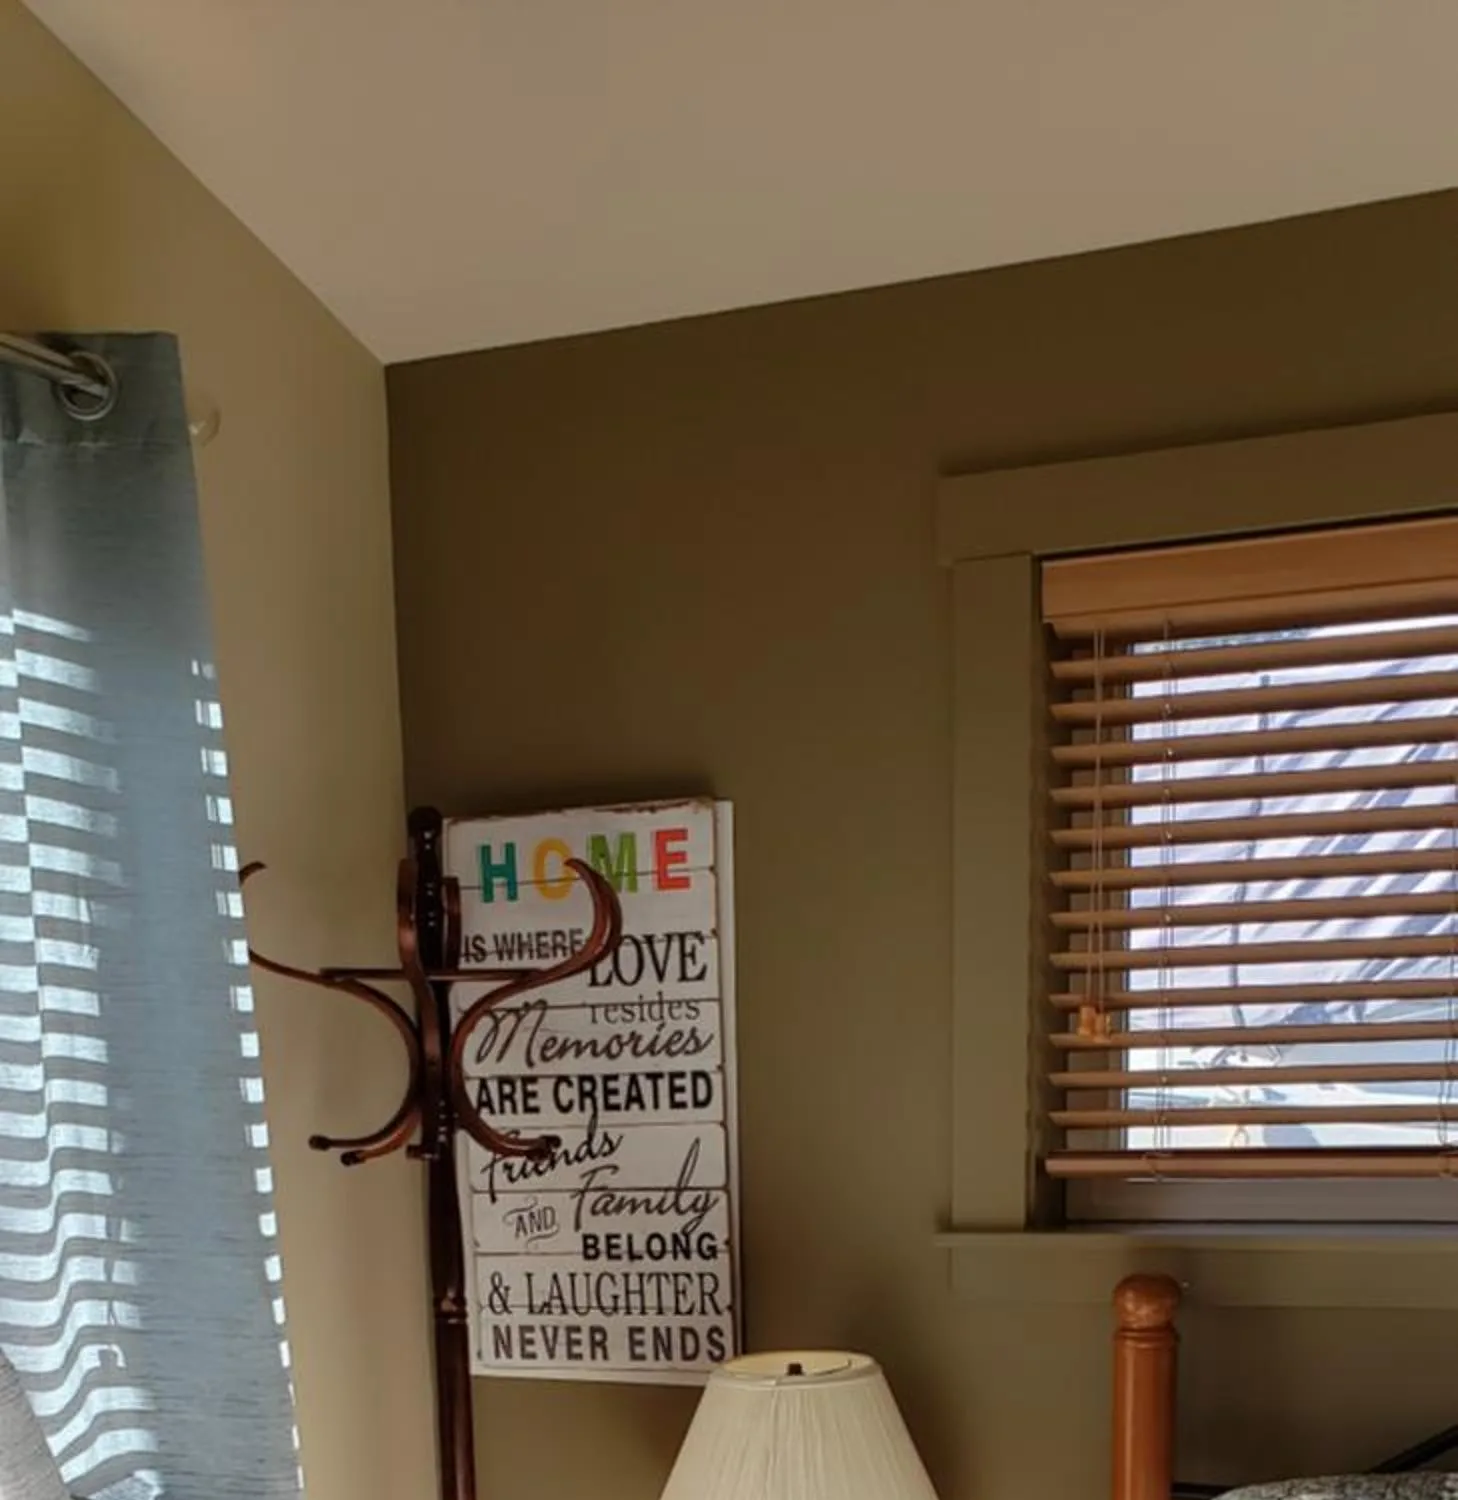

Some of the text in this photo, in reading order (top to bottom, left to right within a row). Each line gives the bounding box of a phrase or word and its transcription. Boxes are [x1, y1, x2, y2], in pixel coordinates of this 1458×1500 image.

[477, 828, 691, 903] HOME
[463, 928, 584, 963] IS WHERE
[590, 991, 701, 1025] resides
[474, 998, 714, 1068] Memories
[476, 1070, 713, 1116] ARE CREATED
[513, 1136, 719, 1239] AND Family
[581, 1232, 719, 1262] BELONG
[487, 1270, 724, 1318] & LAUGHTER
[492, 1324, 726, 1363] NEVER ENDS
